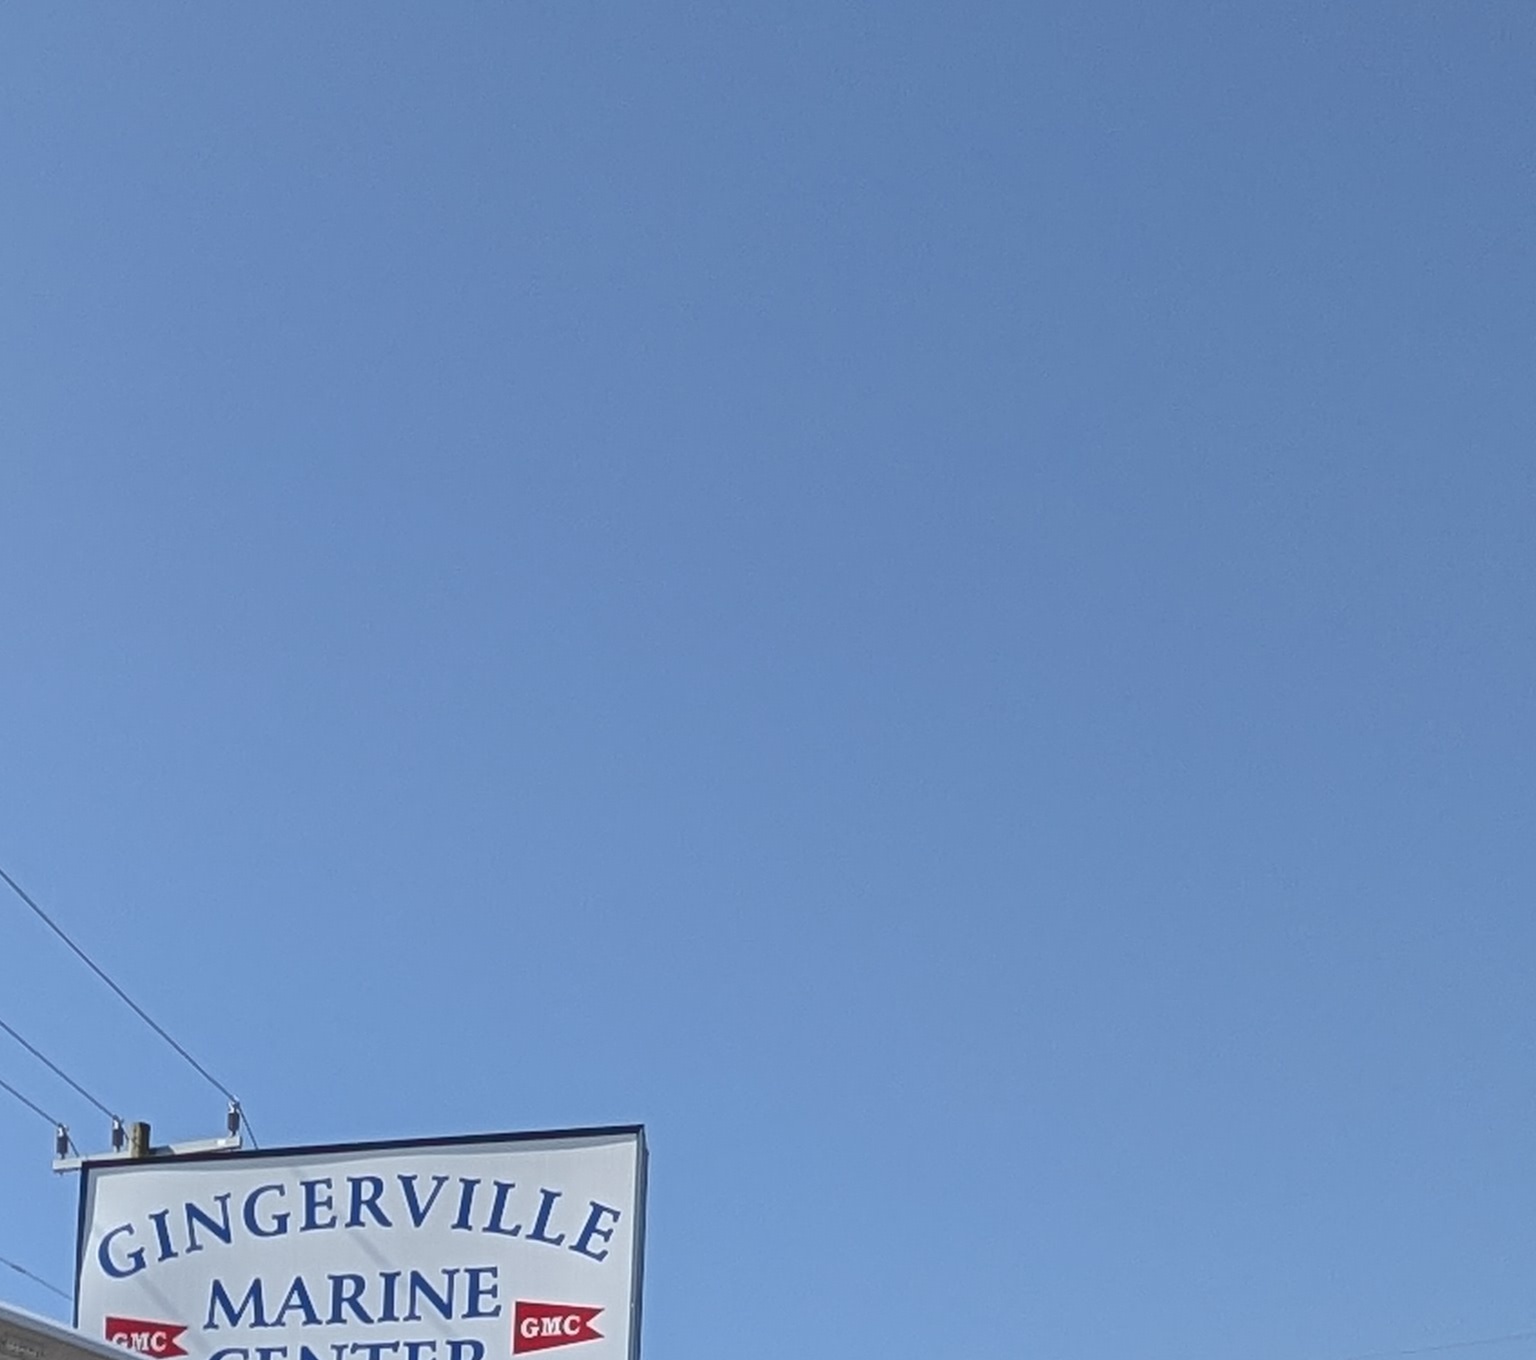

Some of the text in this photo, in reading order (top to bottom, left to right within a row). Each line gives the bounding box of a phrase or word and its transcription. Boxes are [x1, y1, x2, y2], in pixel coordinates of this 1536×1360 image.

[97, 1174, 621, 1279] GINGERVILLE
[202, 1266, 502, 1330] MARINE
[520, 1315, 581, 1339] GMC
